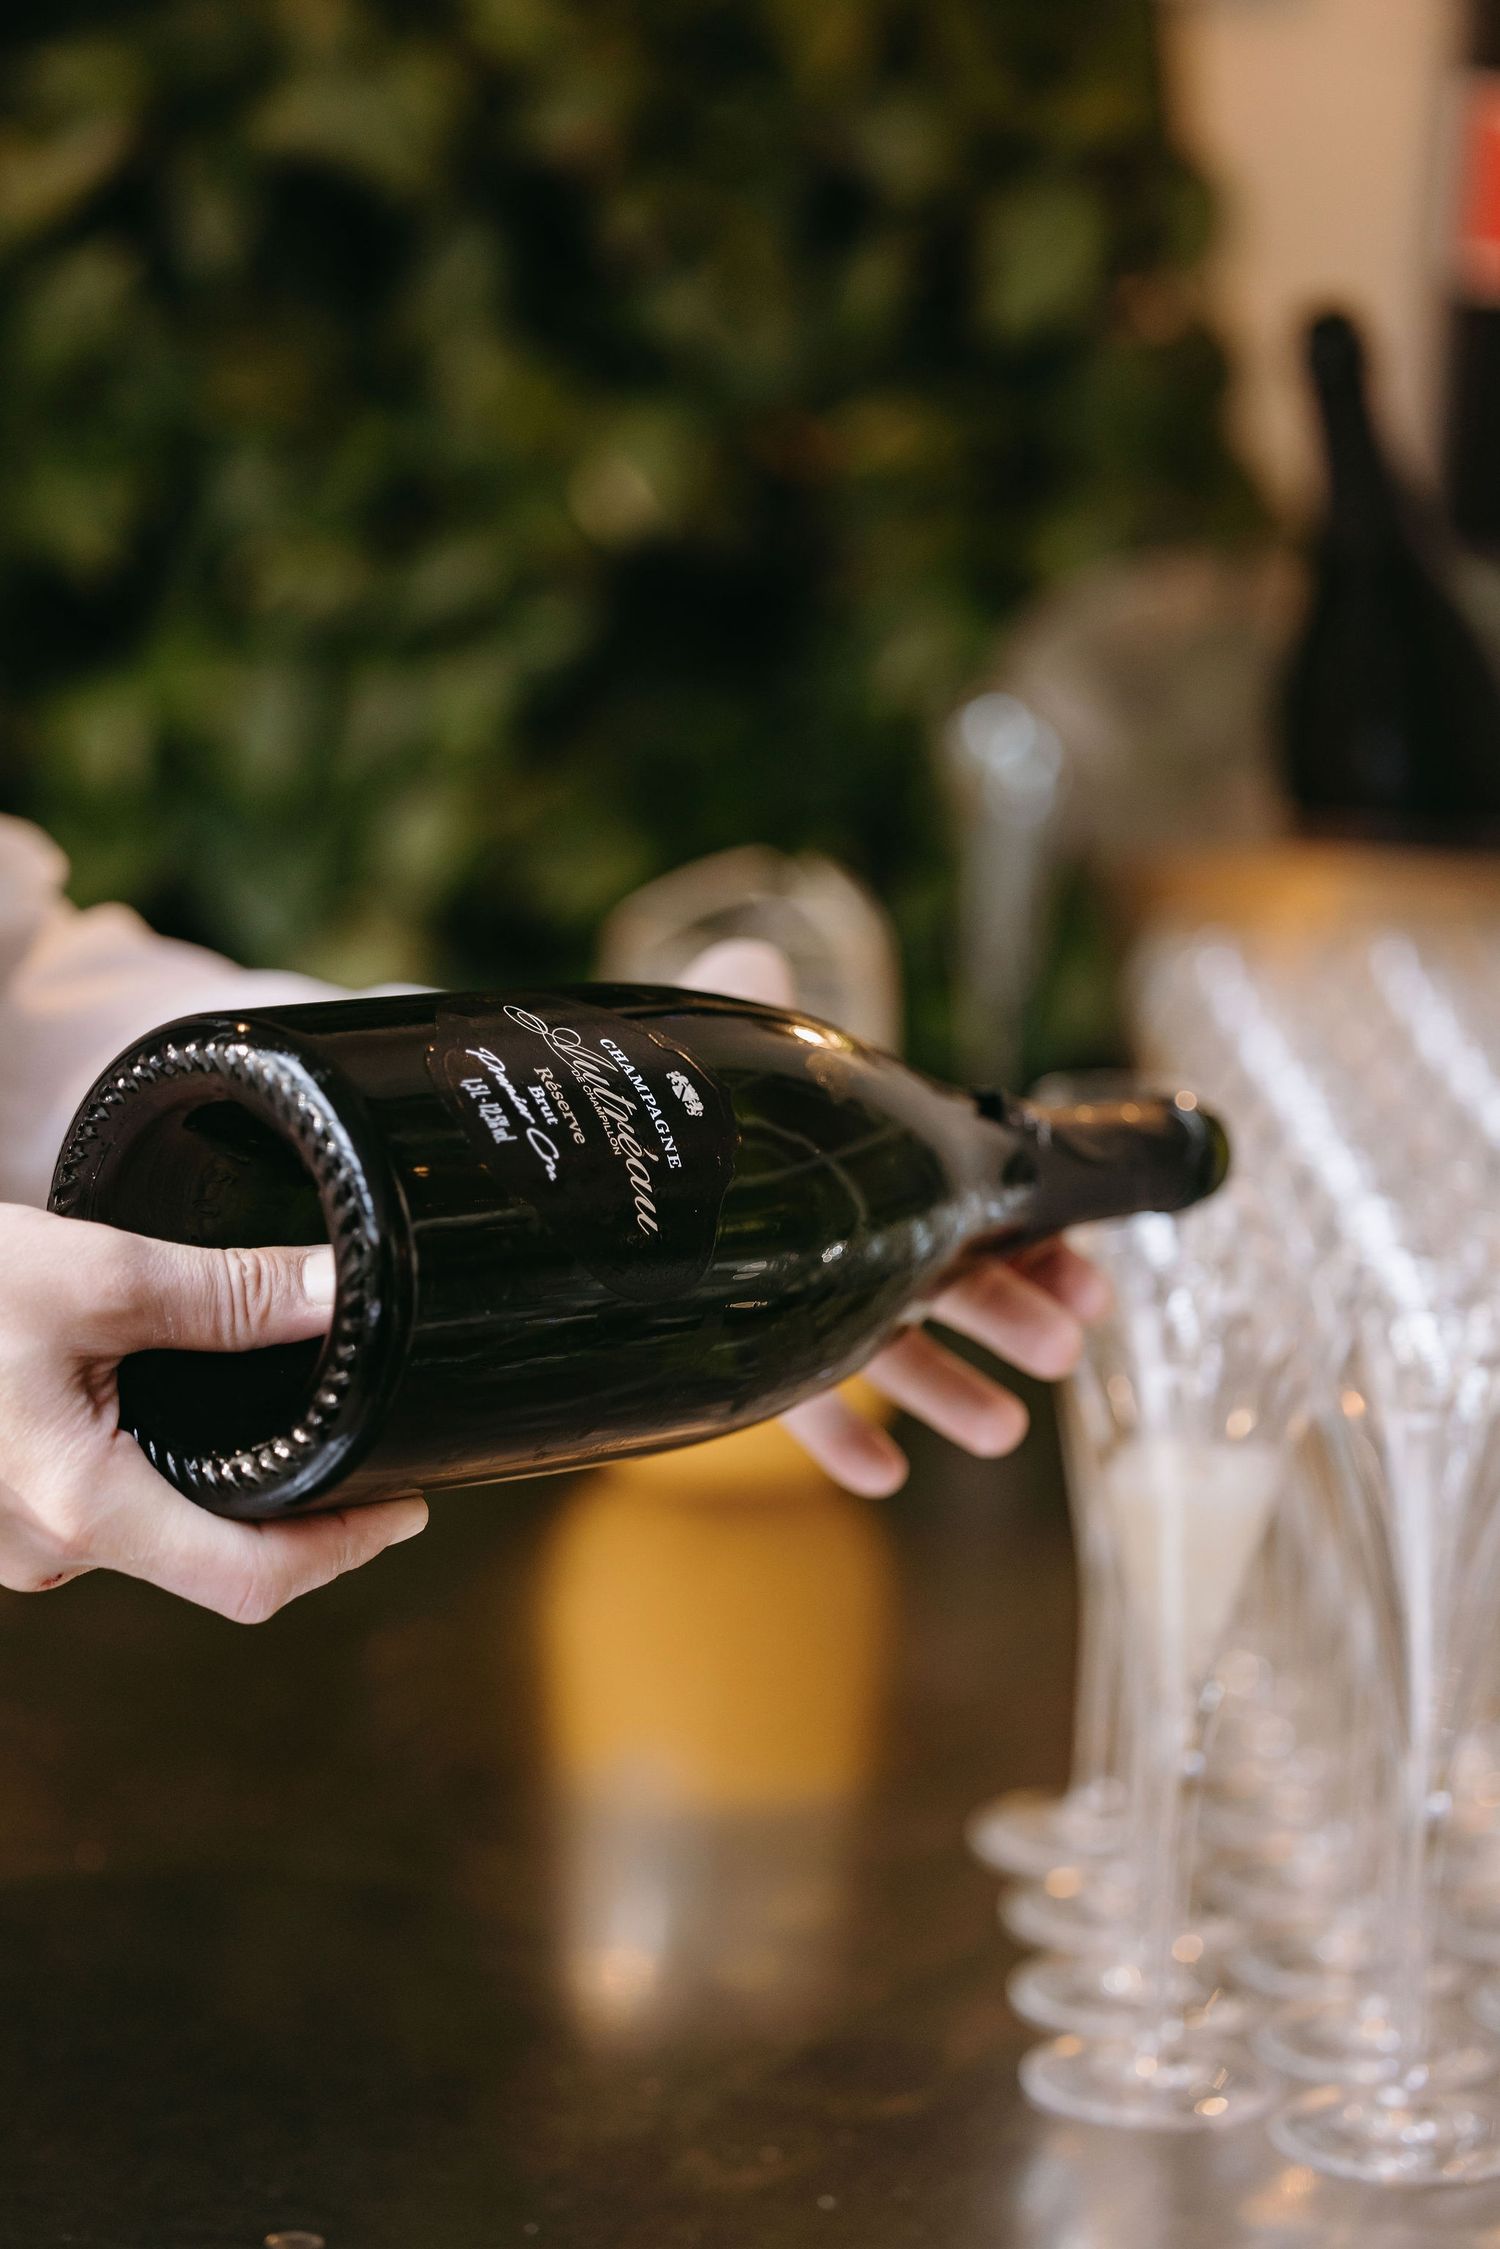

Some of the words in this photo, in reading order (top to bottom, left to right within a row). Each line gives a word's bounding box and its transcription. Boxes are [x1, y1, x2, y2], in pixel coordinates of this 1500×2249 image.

[465, 1047, 536, 1124] Premier
[526, 1127, 560, 1182] Cru
[503, 1005, 658, 1236] Autréau
[527, 1085, 558, 1126] Brut
[533, 1066, 586, 1144] Réserve
[571, 1069, 585, 1083] DE
[582, 1085, 622, 1155] CHAMPILLON
[600, 1038, 682, 1169] CHAMPAGNE
